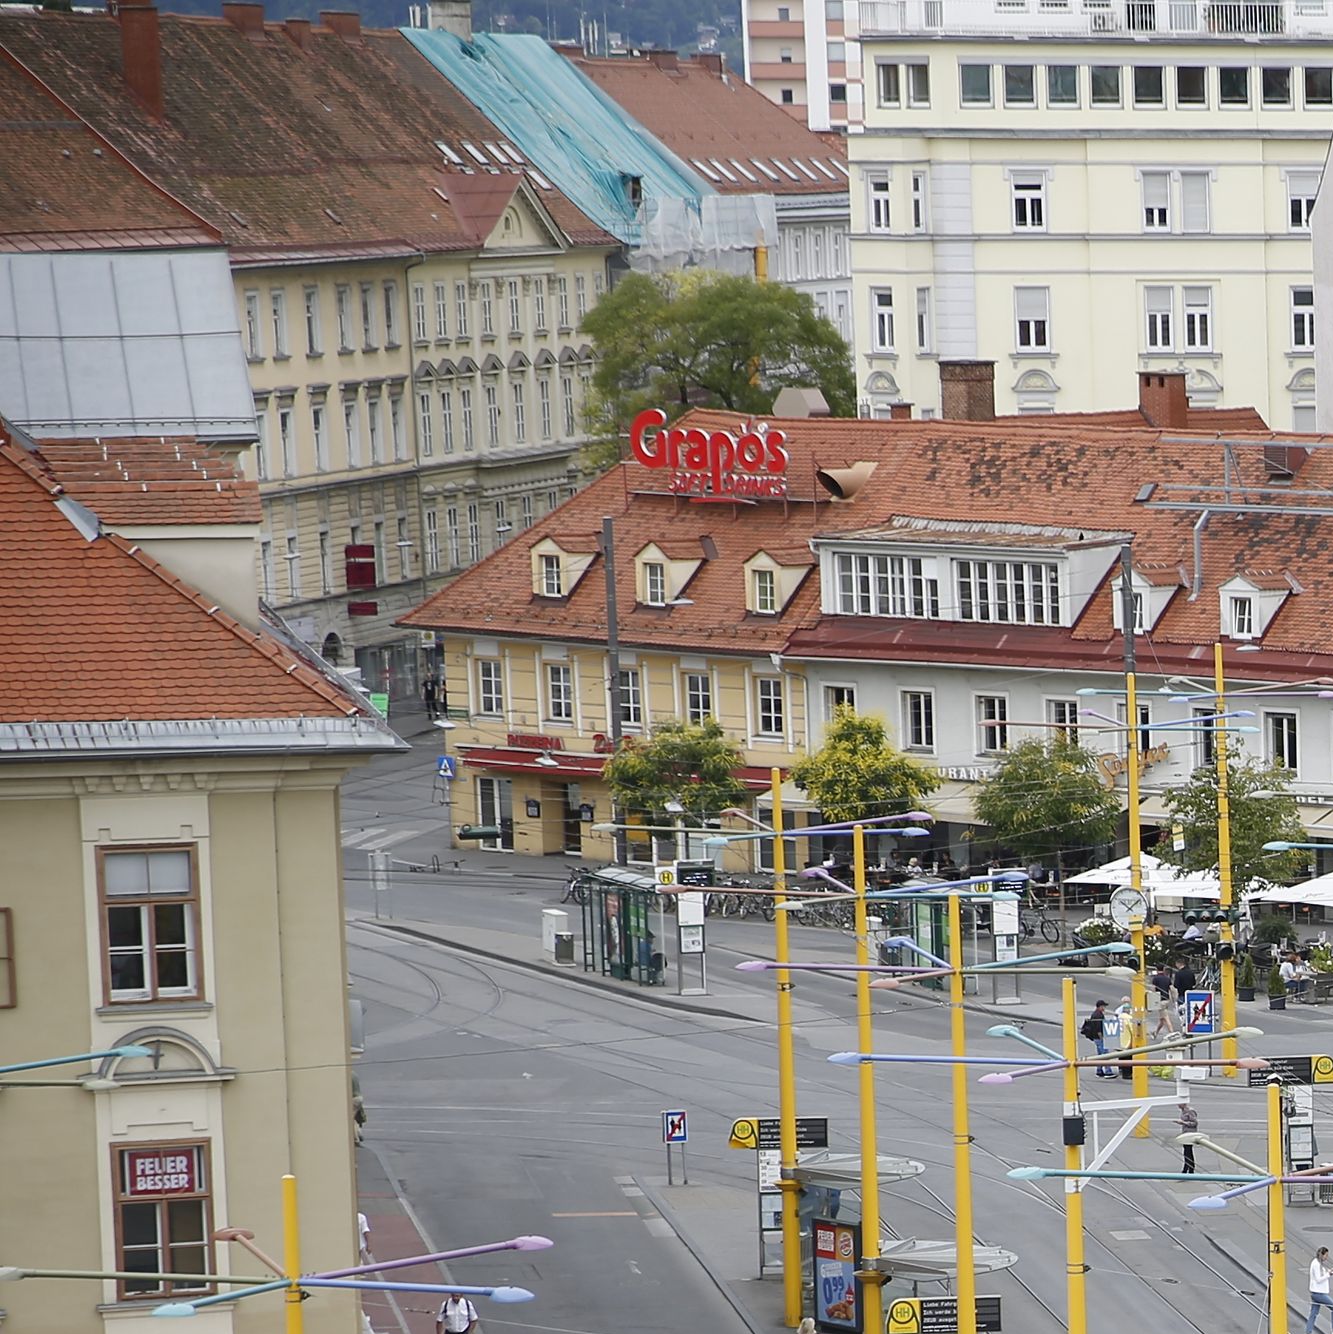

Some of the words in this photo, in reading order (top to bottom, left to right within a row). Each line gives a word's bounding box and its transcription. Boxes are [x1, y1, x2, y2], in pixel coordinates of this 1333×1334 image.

[1104, 1022, 1118, 1035] W
[136, 1156, 188, 1175] FEUER
[136, 1173, 189, 1191] BESSER
